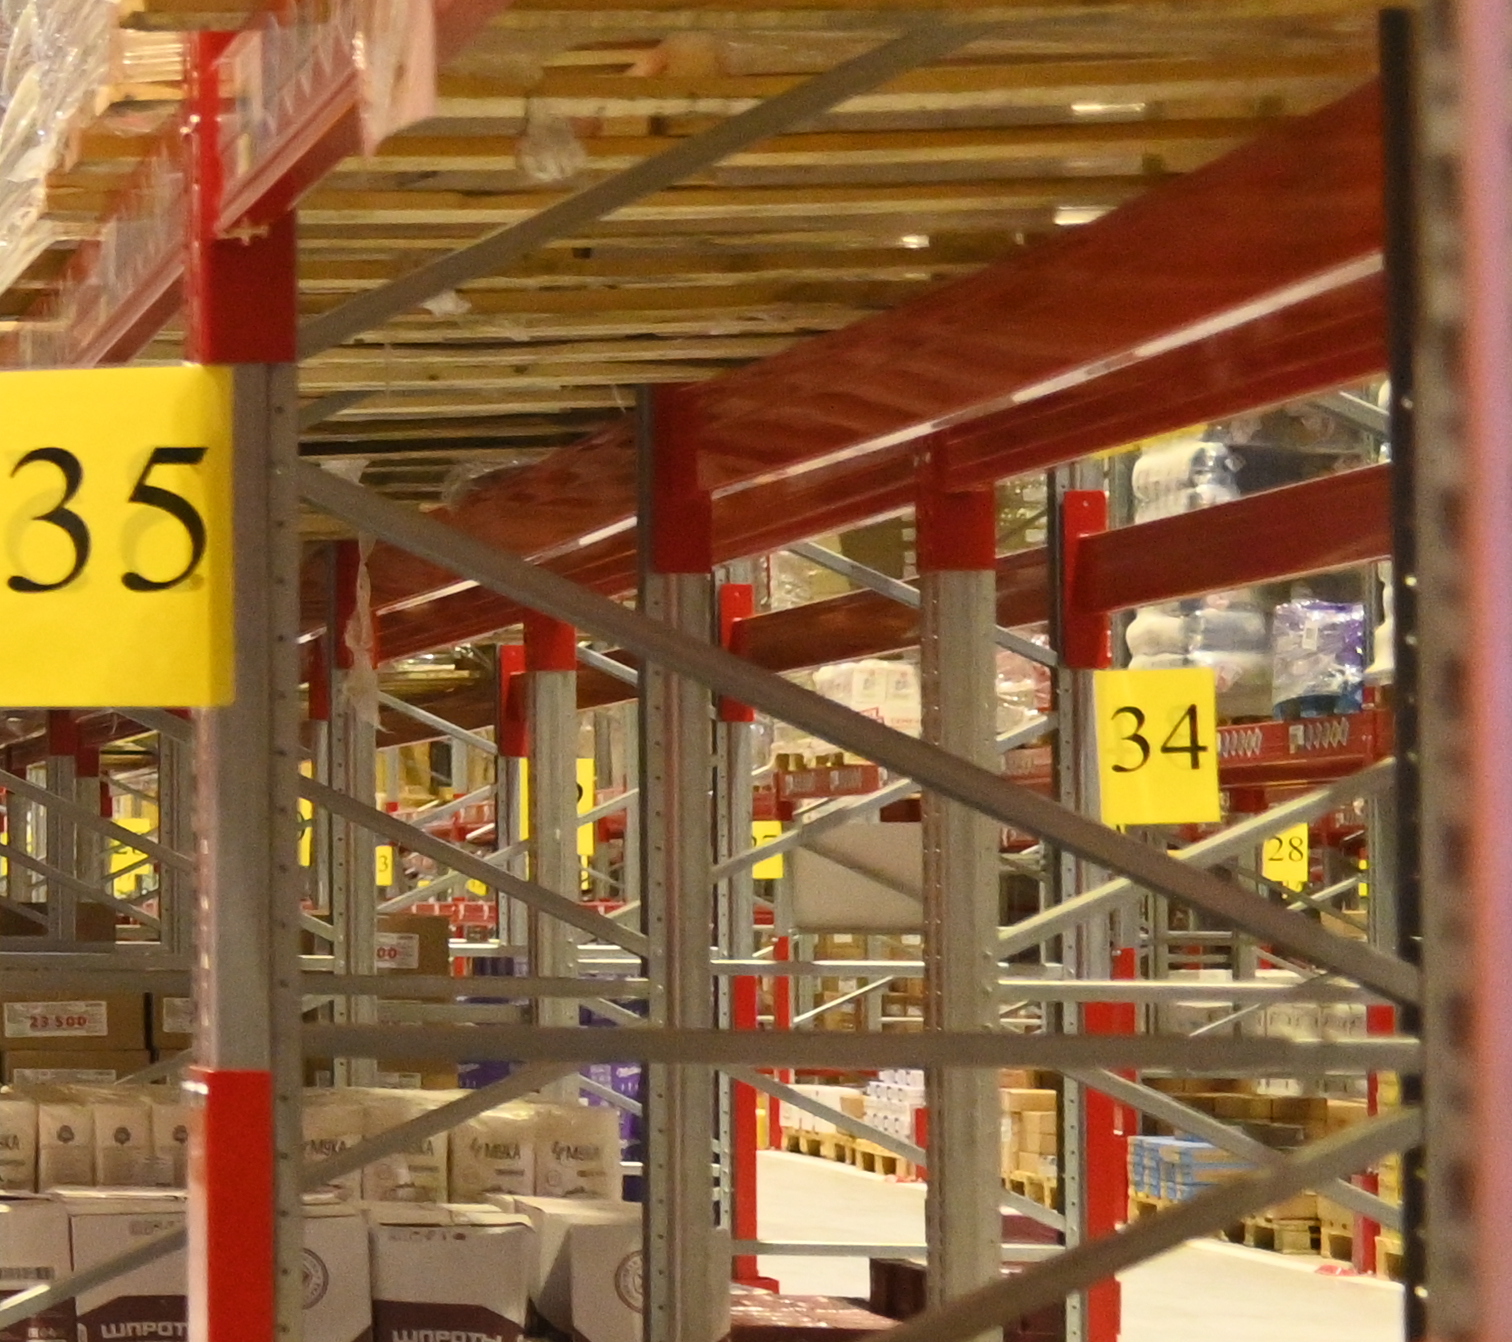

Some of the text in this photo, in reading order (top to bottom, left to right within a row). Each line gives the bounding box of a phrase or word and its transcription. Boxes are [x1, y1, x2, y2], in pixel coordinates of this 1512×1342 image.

[6, 445, 207, 593] 35
[1111, 703, 1208, 773] 34
[1267, 836, 1304, 862] 28
[376, 947, 397, 959] 00
[29, 1015, 87, 1029] 23 500
[101, 1322, 187, 1339] ШПРОТ
